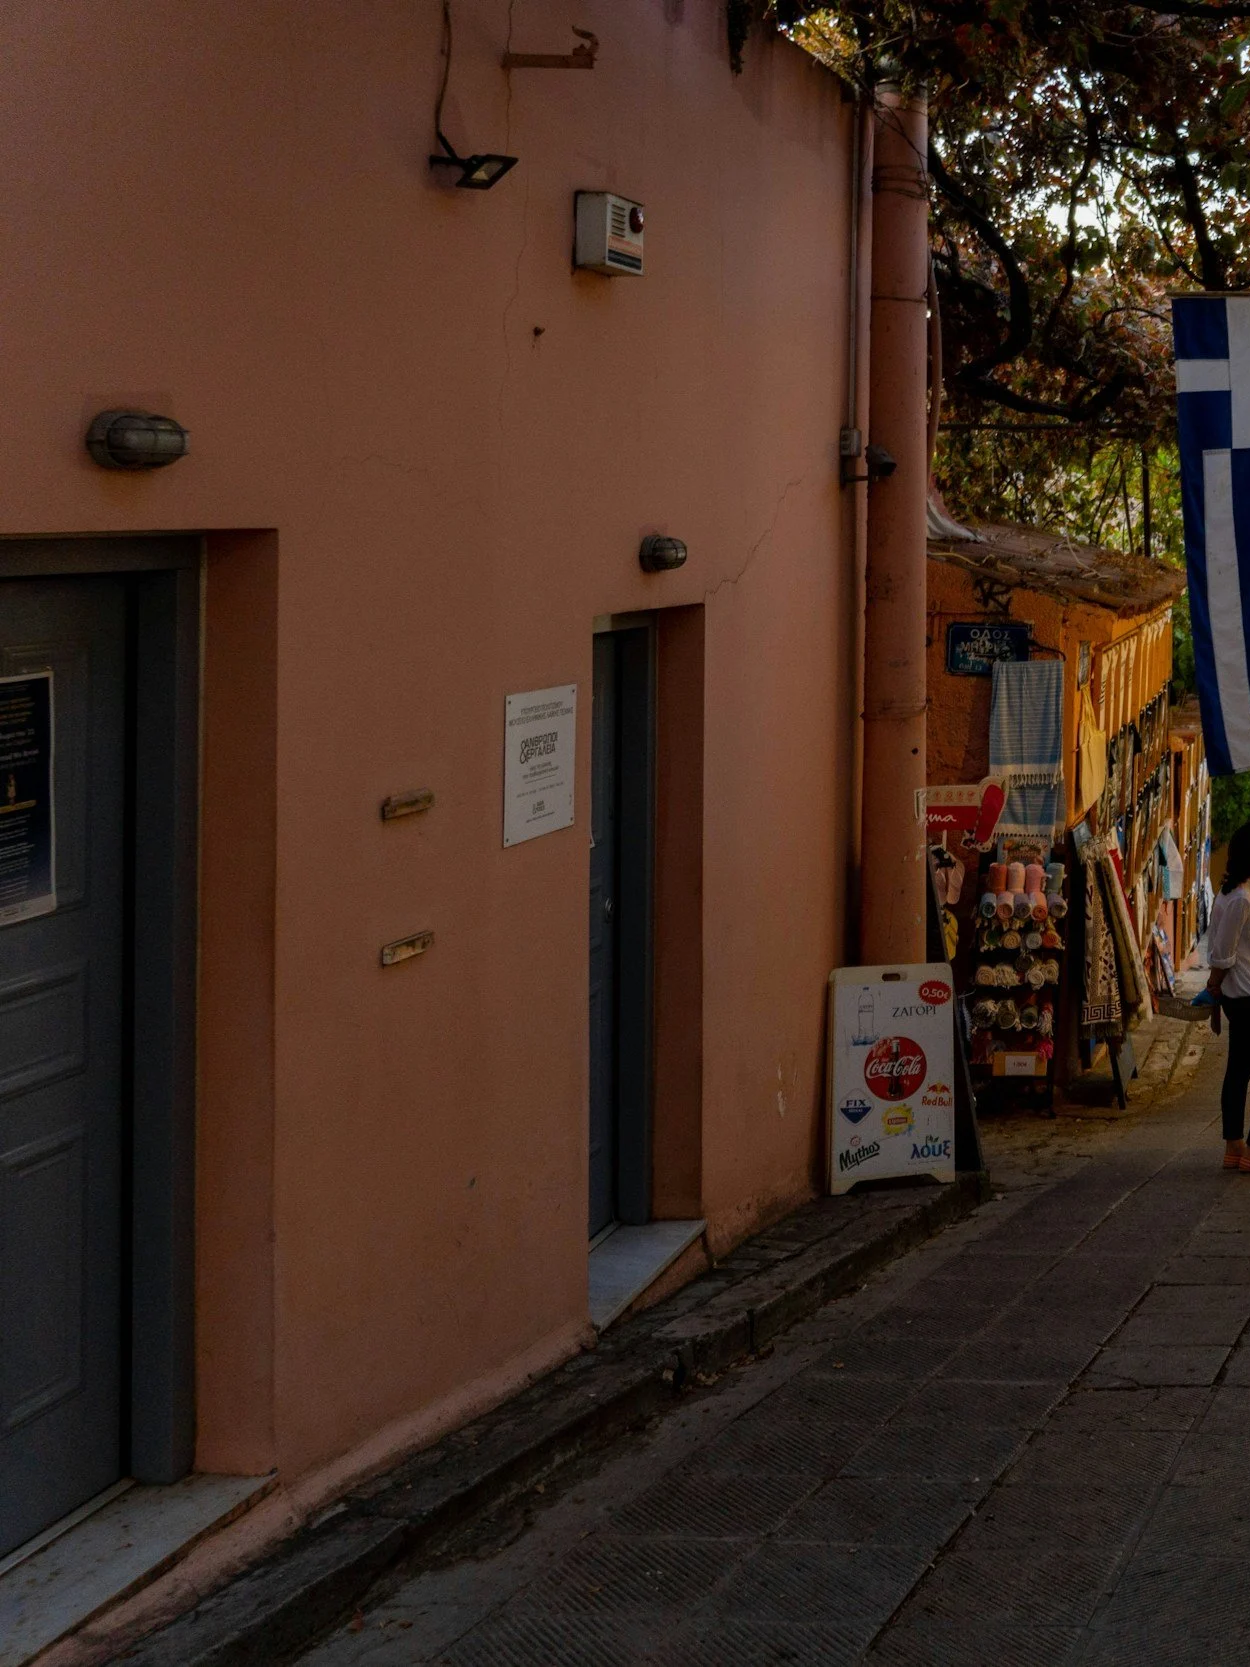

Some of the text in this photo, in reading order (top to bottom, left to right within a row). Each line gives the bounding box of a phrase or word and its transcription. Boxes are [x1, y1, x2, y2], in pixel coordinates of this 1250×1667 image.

[865, 1055, 923, 1079] Coca-Cola
[846, 1099, 866, 1107] FIX
[921, 1095, 937, 1107] Red
[839, 1141, 881, 1172] Mythos
